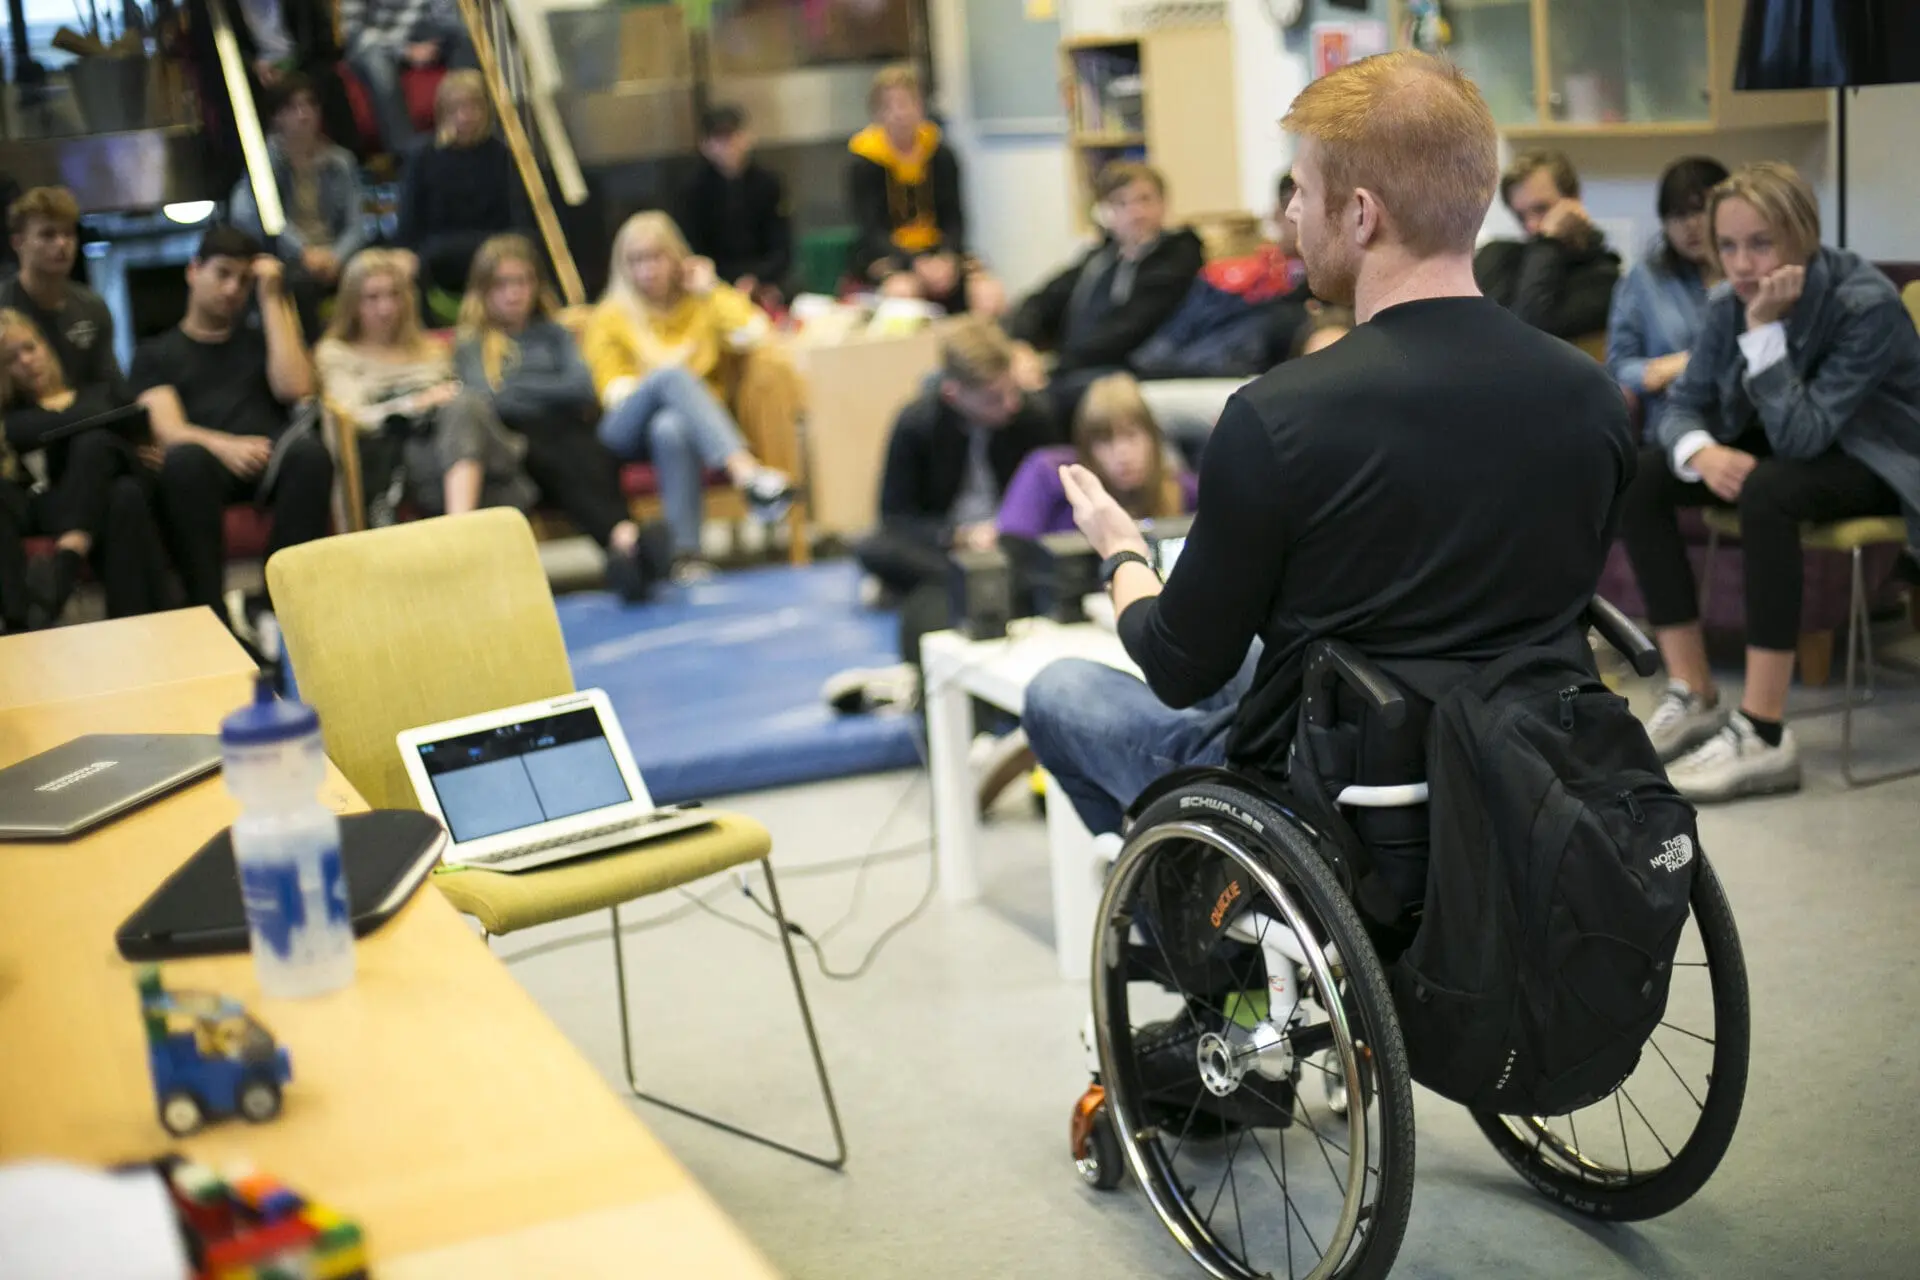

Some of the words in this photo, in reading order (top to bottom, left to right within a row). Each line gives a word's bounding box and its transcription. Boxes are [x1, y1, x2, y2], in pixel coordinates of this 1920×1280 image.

[1180, 796, 1264, 833] SCHWALBE
[1661, 836, 1682, 850] THE
[1650, 846, 1684, 869] NORTH
[1665, 855, 1688, 872] FACE
